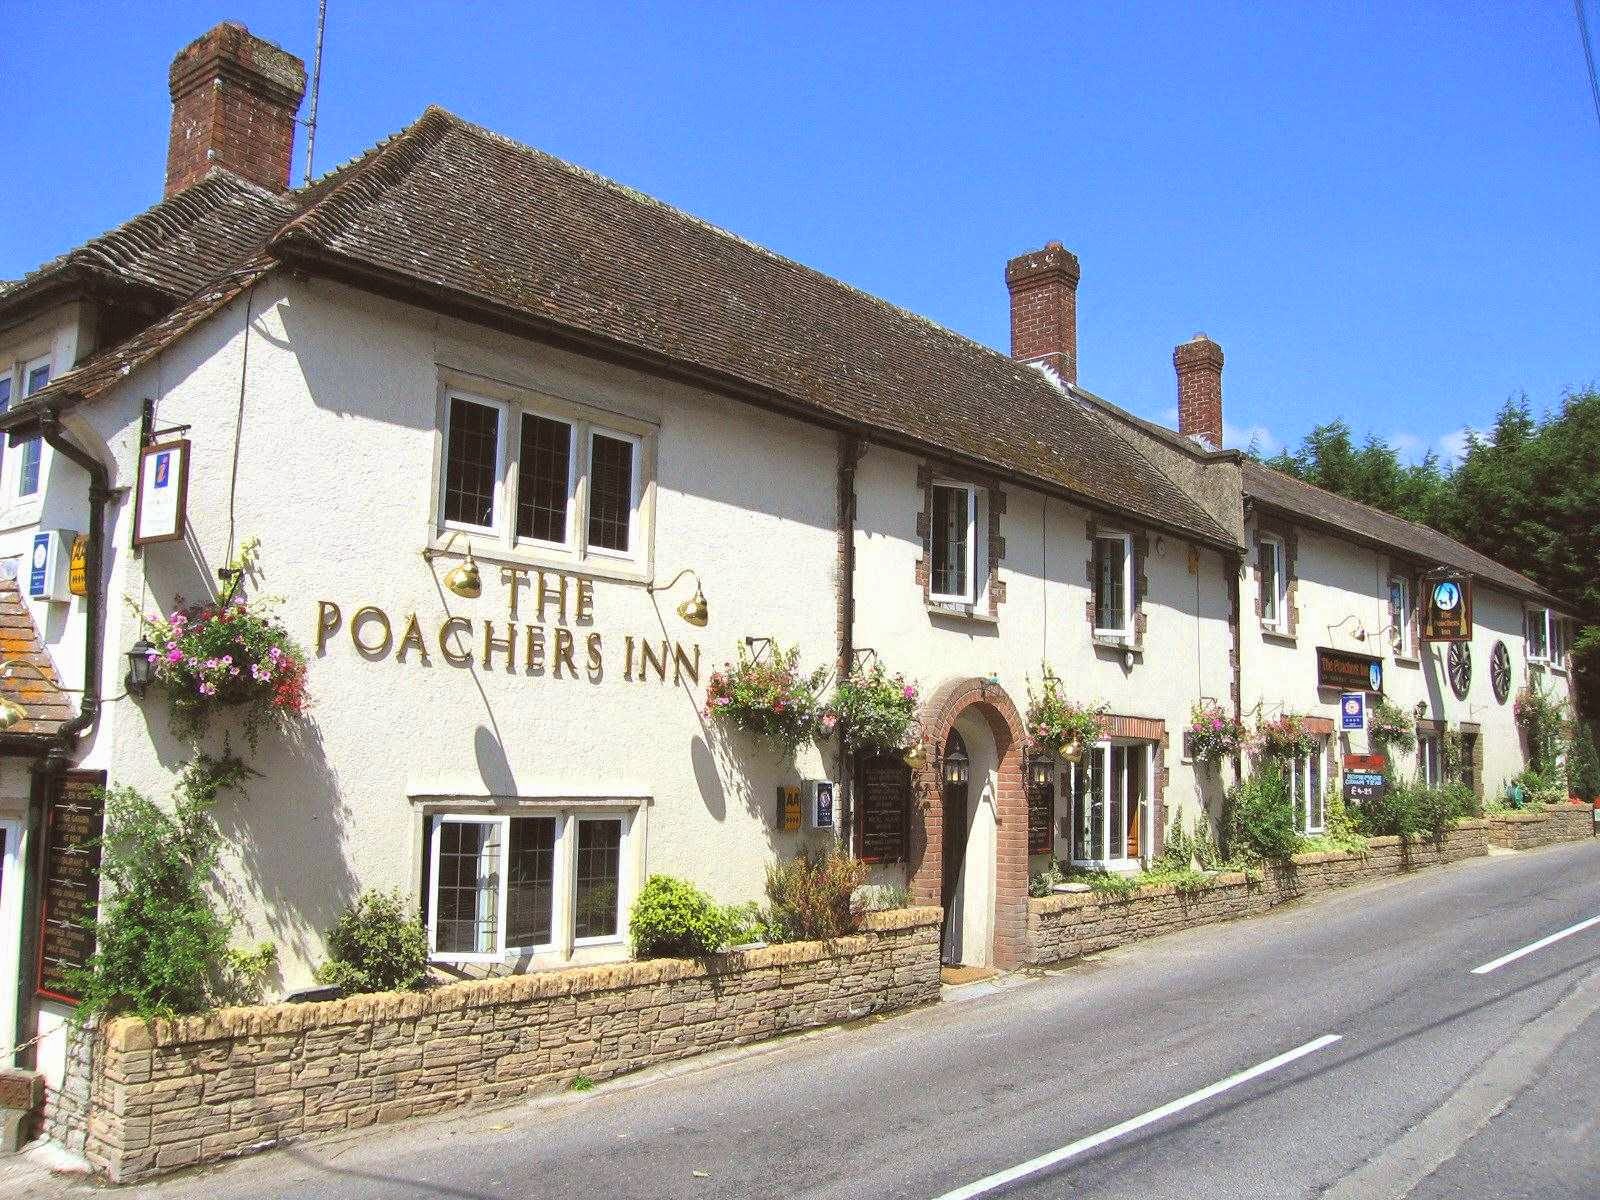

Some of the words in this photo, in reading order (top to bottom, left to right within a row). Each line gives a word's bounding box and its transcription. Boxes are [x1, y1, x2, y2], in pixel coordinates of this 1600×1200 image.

[501, 567, 594, 624] THE
[315, 600, 603, 676] POACHERS
[624, 636, 702, 685] INN
